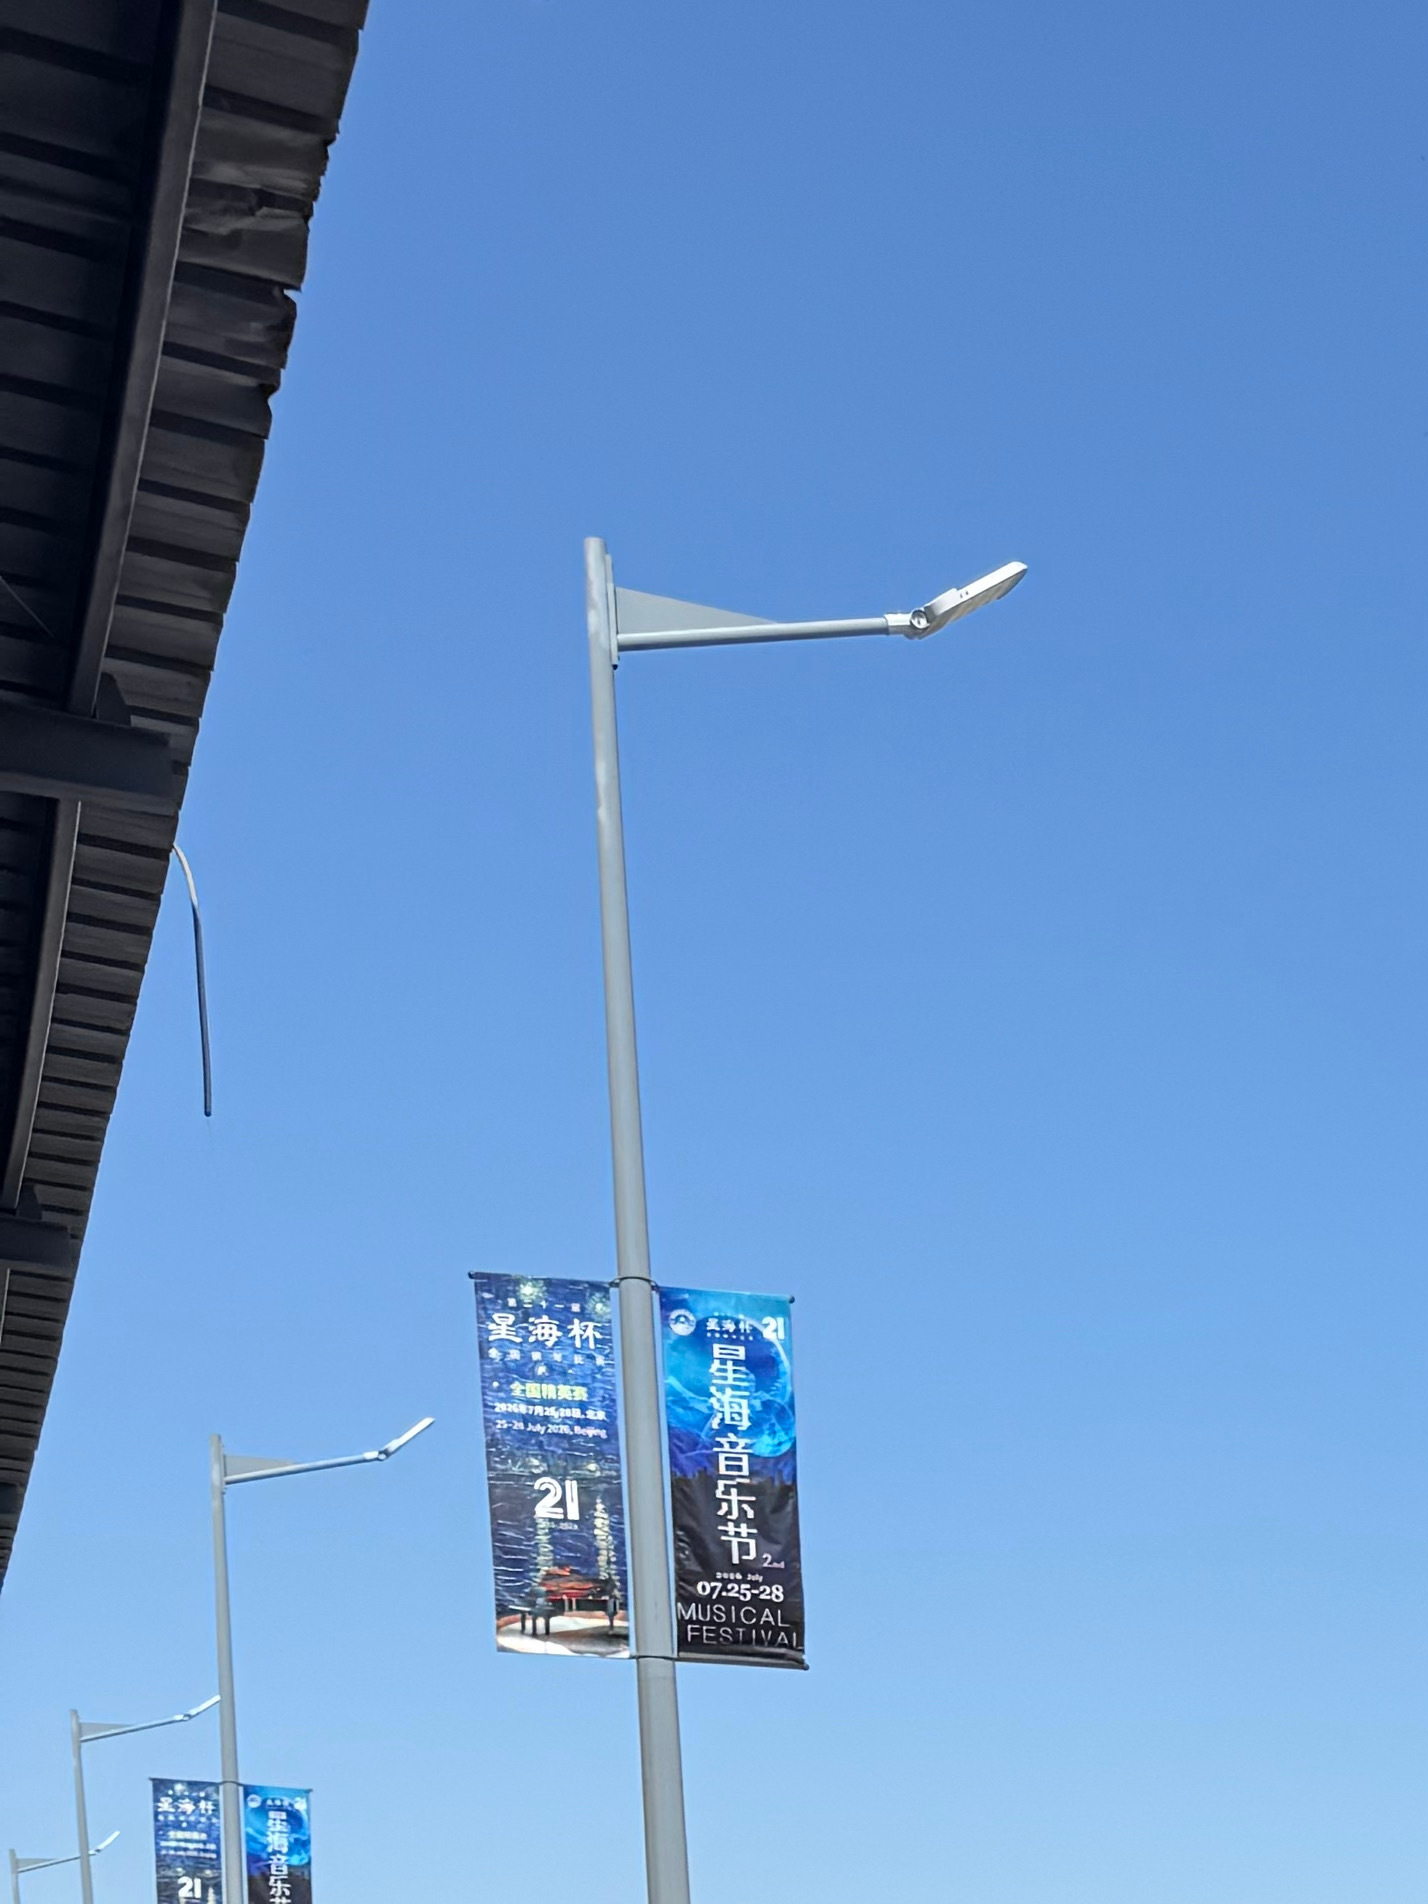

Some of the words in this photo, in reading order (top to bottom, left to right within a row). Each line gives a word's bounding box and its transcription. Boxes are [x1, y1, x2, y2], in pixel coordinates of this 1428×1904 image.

[488, 1313, 603, 1349] 星海杯
[761, 1316, 785, 1340] 21
[709, 1343, 757, 1564] 星海音乐节
[534, 1477, 580, 1520] 21
[696, 1581, 784, 1602] 07.25-28
[677, 1602, 791, 1627] MUSICAL
[687, 1624, 804, 1650] FESTIVAL
[177, 1876, 201, 1898] 21
